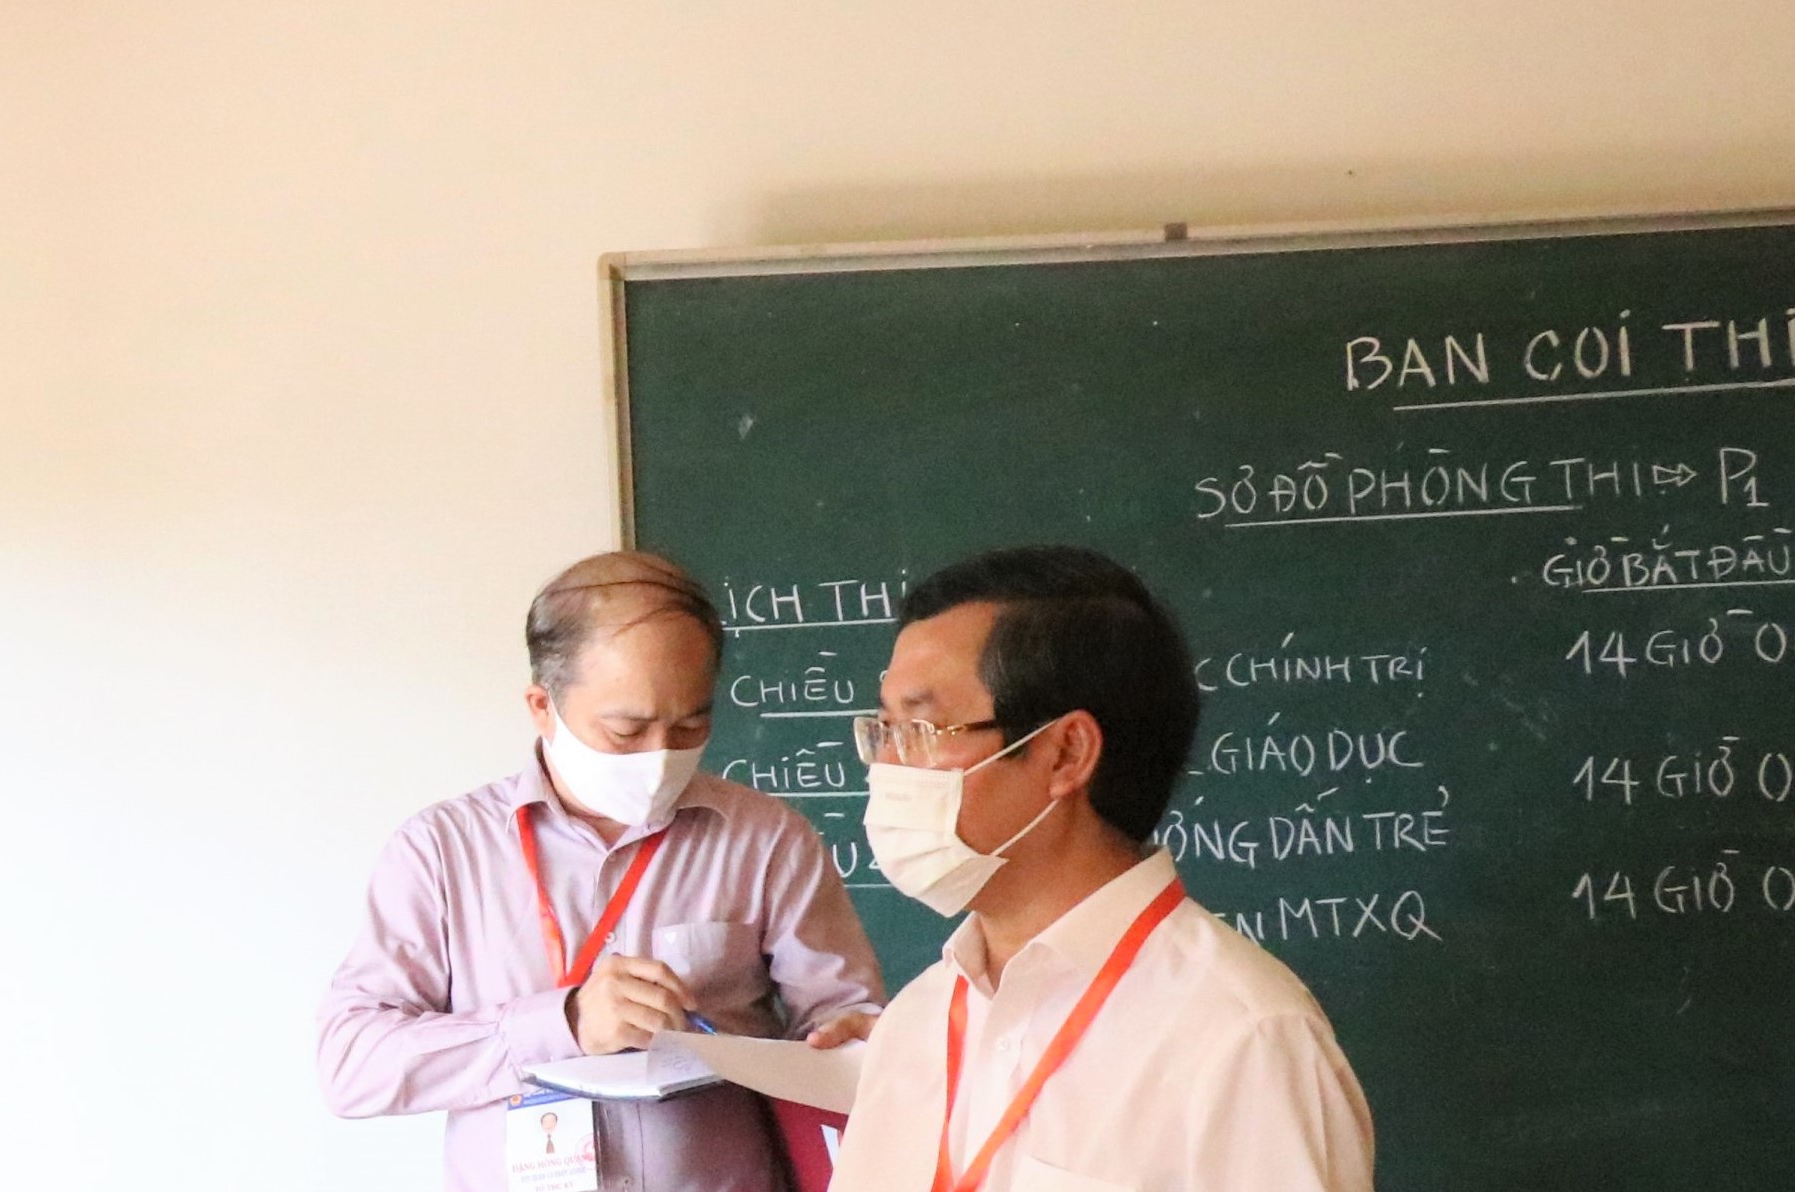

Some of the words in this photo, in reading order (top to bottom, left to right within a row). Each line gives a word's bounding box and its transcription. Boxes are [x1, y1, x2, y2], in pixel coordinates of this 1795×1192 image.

[1346, 333, 1489, 391] BAN
[1524, 309, 1631, 381] COI
[1661, 307, 1795, 371] THI
[1550, 457, 1642, 500] THI
[1622, 524, 1700, 587] BẮT
[720, 581, 804, 638] ỊCH
[730, 651, 855, 708] CHIỀU
[1226, 632, 1352, 687] CHÍNH
[1360, 646, 1428, 698] TRỊ
[1565, 630, 1637, 679] 14
[1210, 712, 1315, 777] GIÁO
[1328, 729, 1424, 784] DỤC
[1572, 755, 1641, 805] 14
[1361, 784, 1451, 852] TRẺ
[1278, 889, 1444, 942] MTXQ
[1571, 870, 1637, 920] 14
